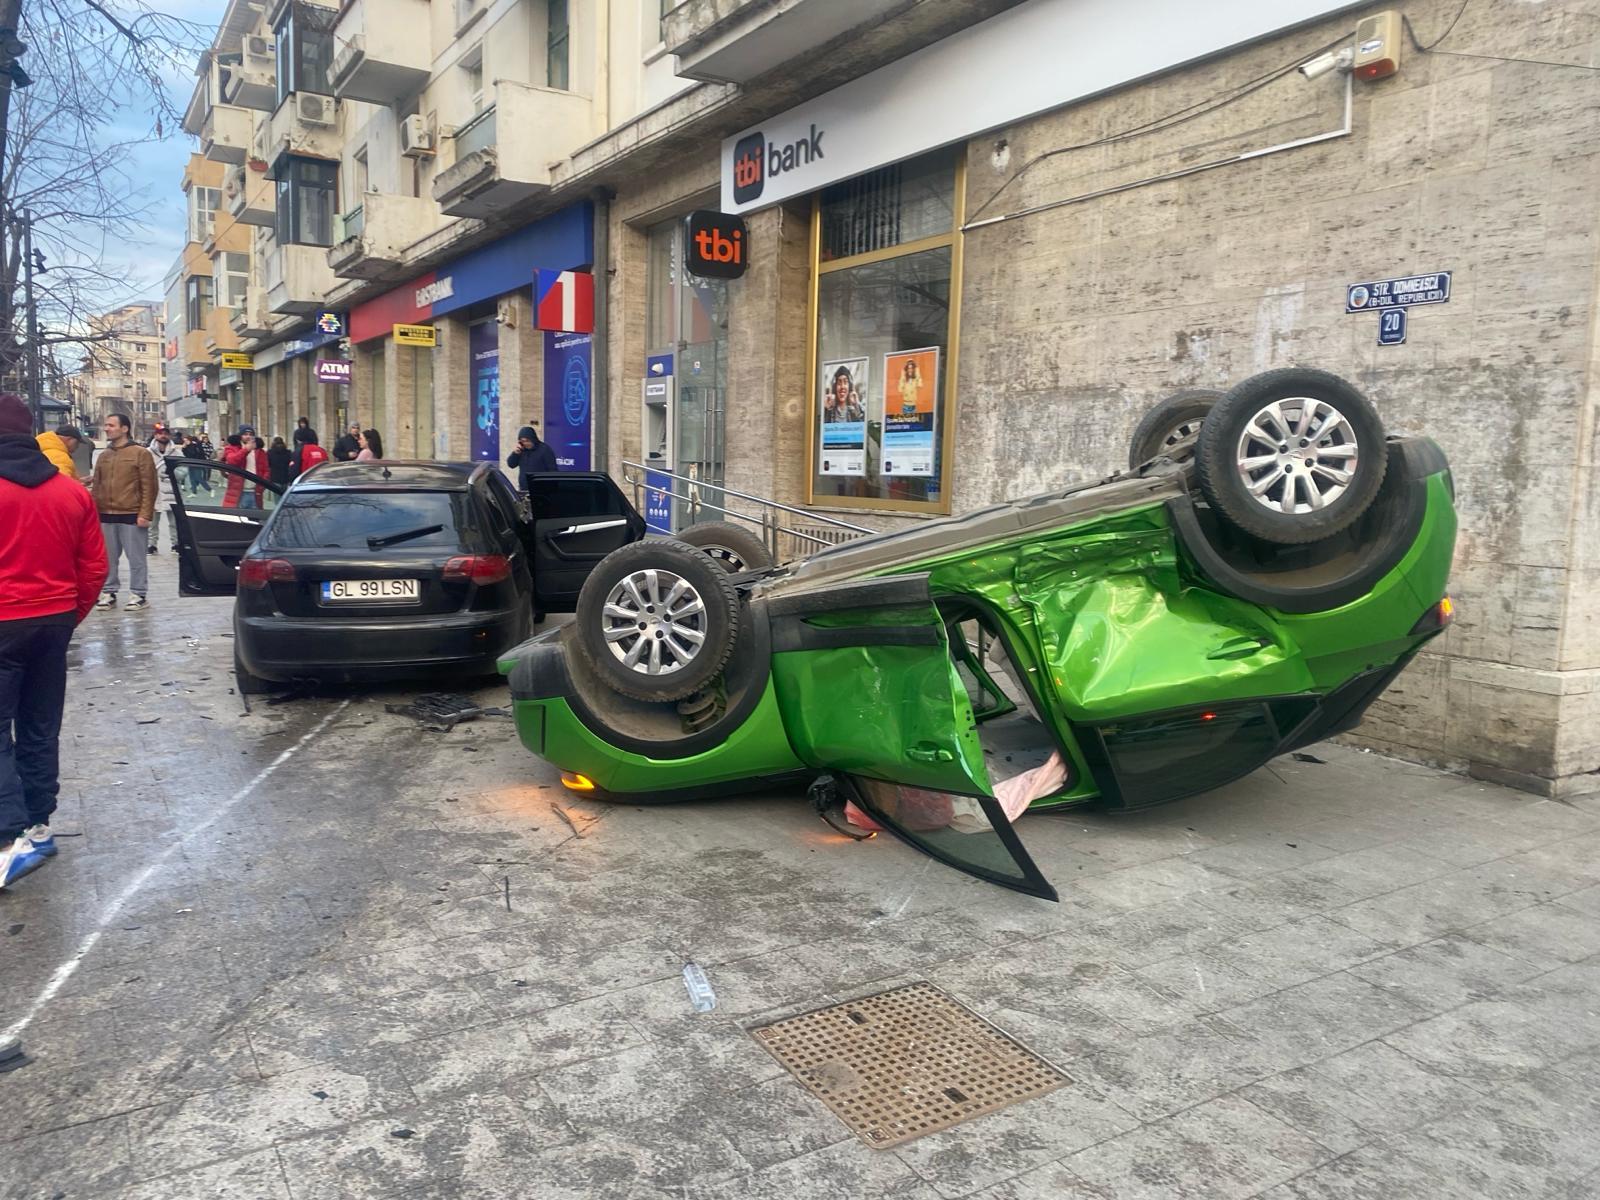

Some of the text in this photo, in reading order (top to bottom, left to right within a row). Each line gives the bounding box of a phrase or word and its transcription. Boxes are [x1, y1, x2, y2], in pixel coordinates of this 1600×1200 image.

[736, 124, 824, 188] tbi bank
[695, 227, 741, 264] tbi
[1373, 282, 1390, 296] STR.
[1368, 295, 1395, 306] (B-DUL
[1384, 313, 1400, 331] 20
[320, 362, 350, 374] ATM
[333, 580, 414, 597] GL 99 LSN
